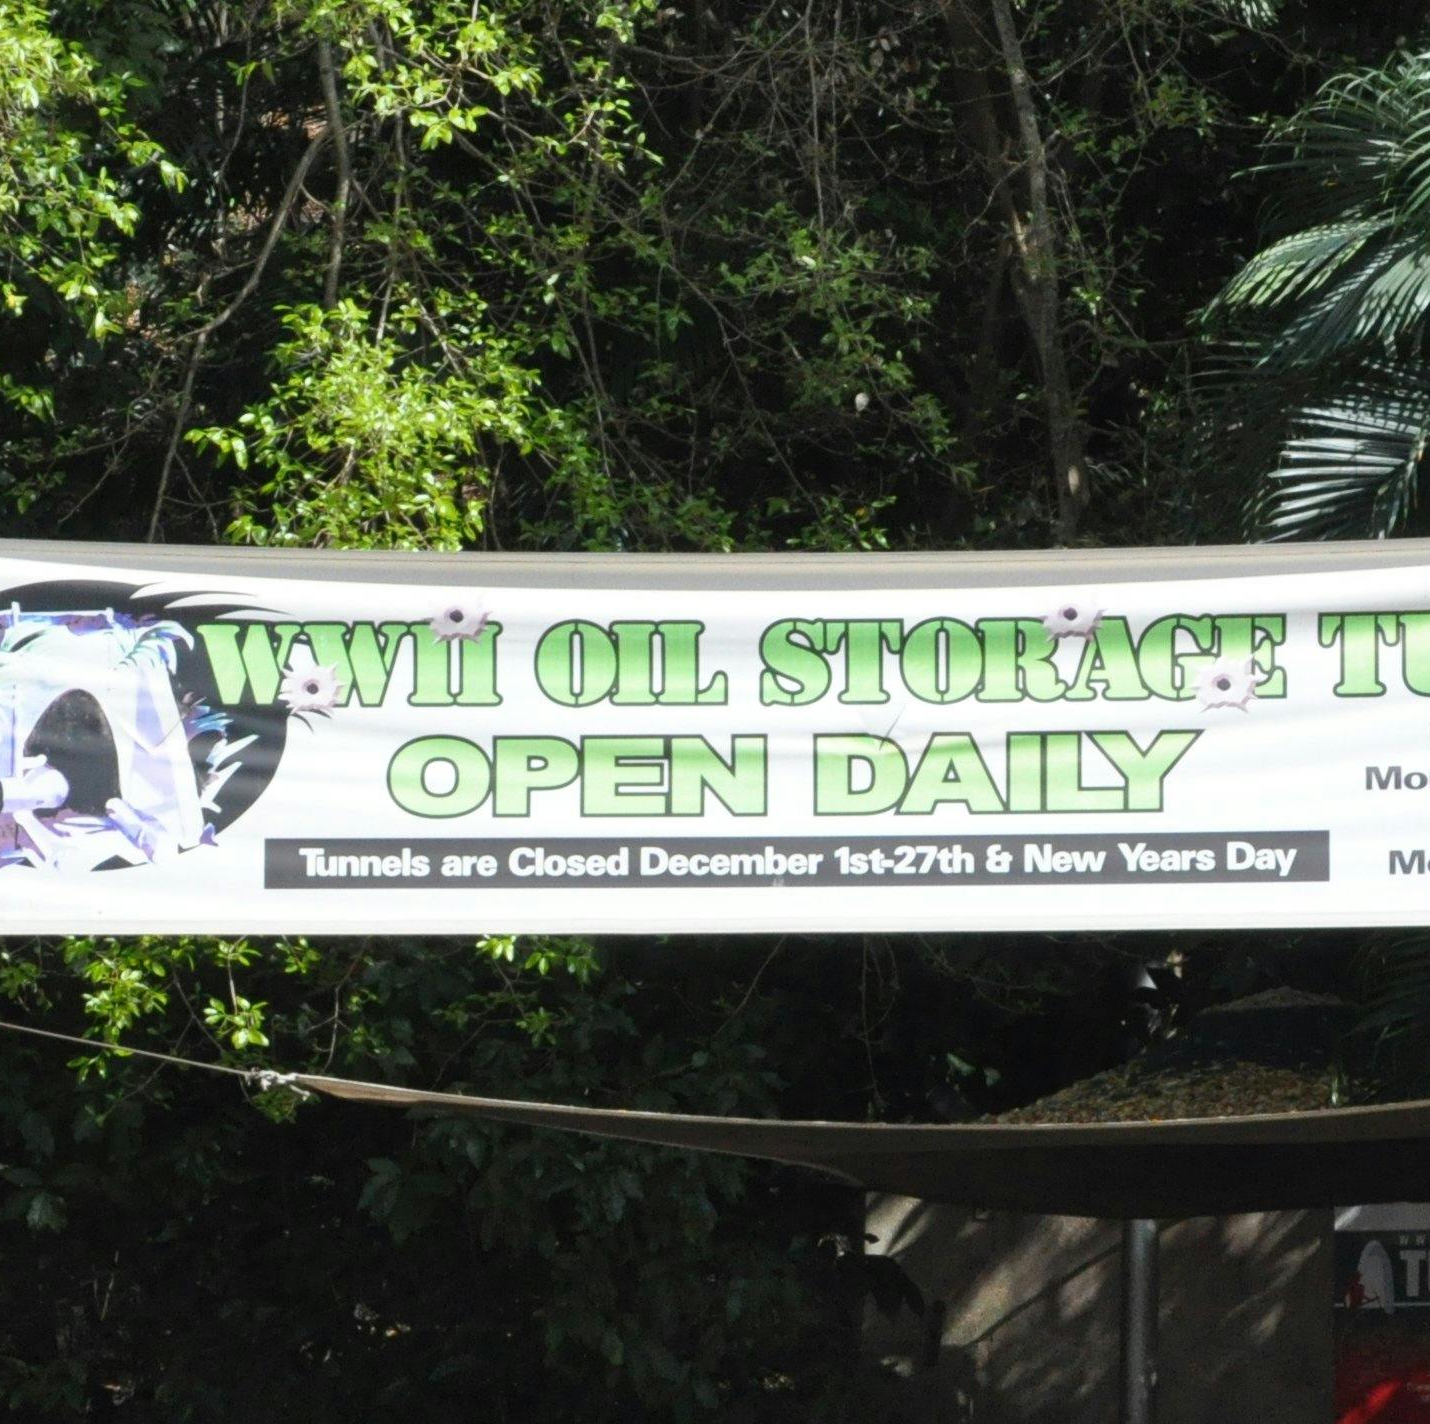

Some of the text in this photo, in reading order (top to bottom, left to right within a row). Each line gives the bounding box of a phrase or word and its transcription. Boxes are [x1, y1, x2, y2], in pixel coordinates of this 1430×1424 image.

[197, 619, 504, 707] WWII
[534, 618, 729, 707] OIL
[759, 614, 1287, 705] STORAGE
[386, 729, 1206, 819] OPEN DAILY
[299, 840, 1298, 878] Tunnels are Closed December 1st-27th & New Years Day
